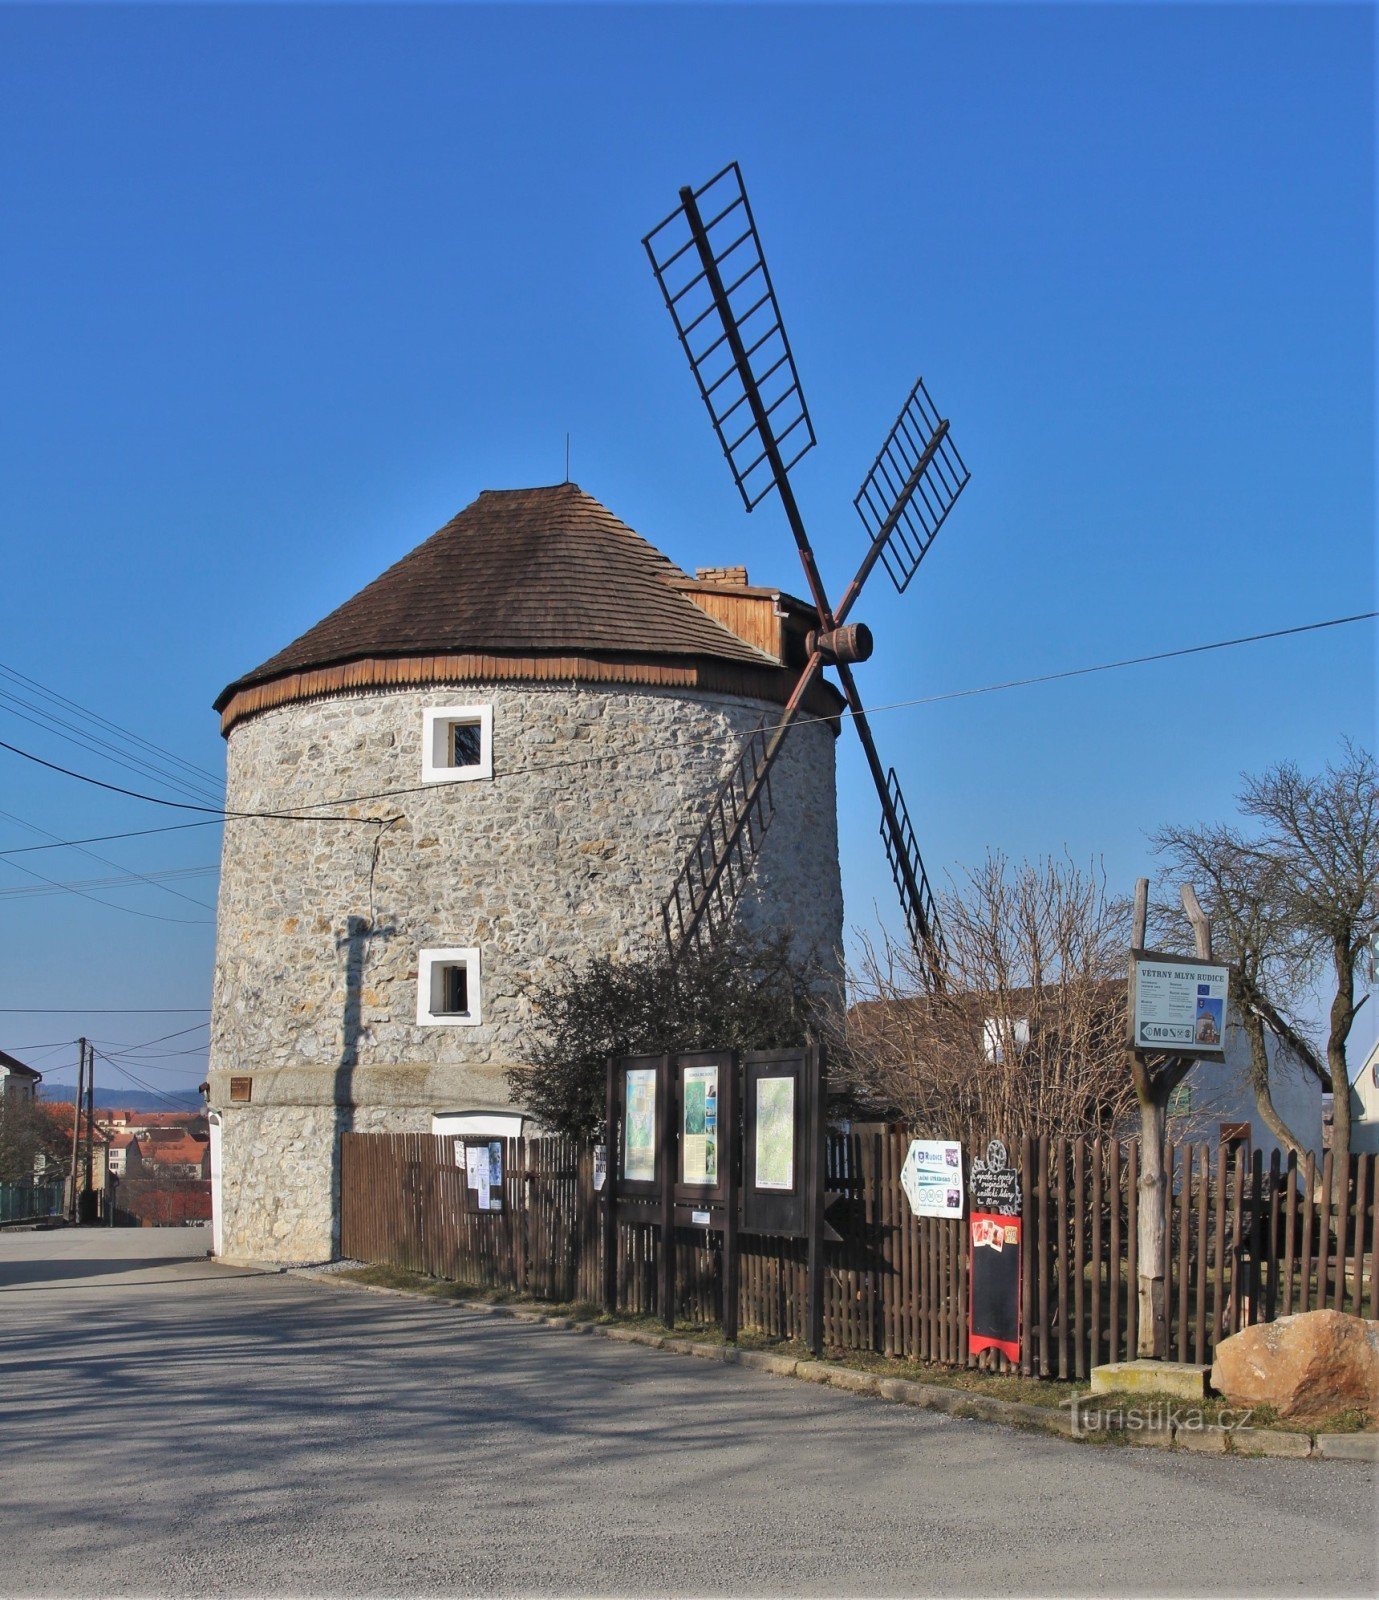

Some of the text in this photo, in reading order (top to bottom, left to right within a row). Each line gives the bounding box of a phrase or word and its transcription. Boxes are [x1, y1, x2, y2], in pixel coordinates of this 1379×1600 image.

[1142, 969, 1225, 982] VĚTRNÝ MLÝN RUDICE
